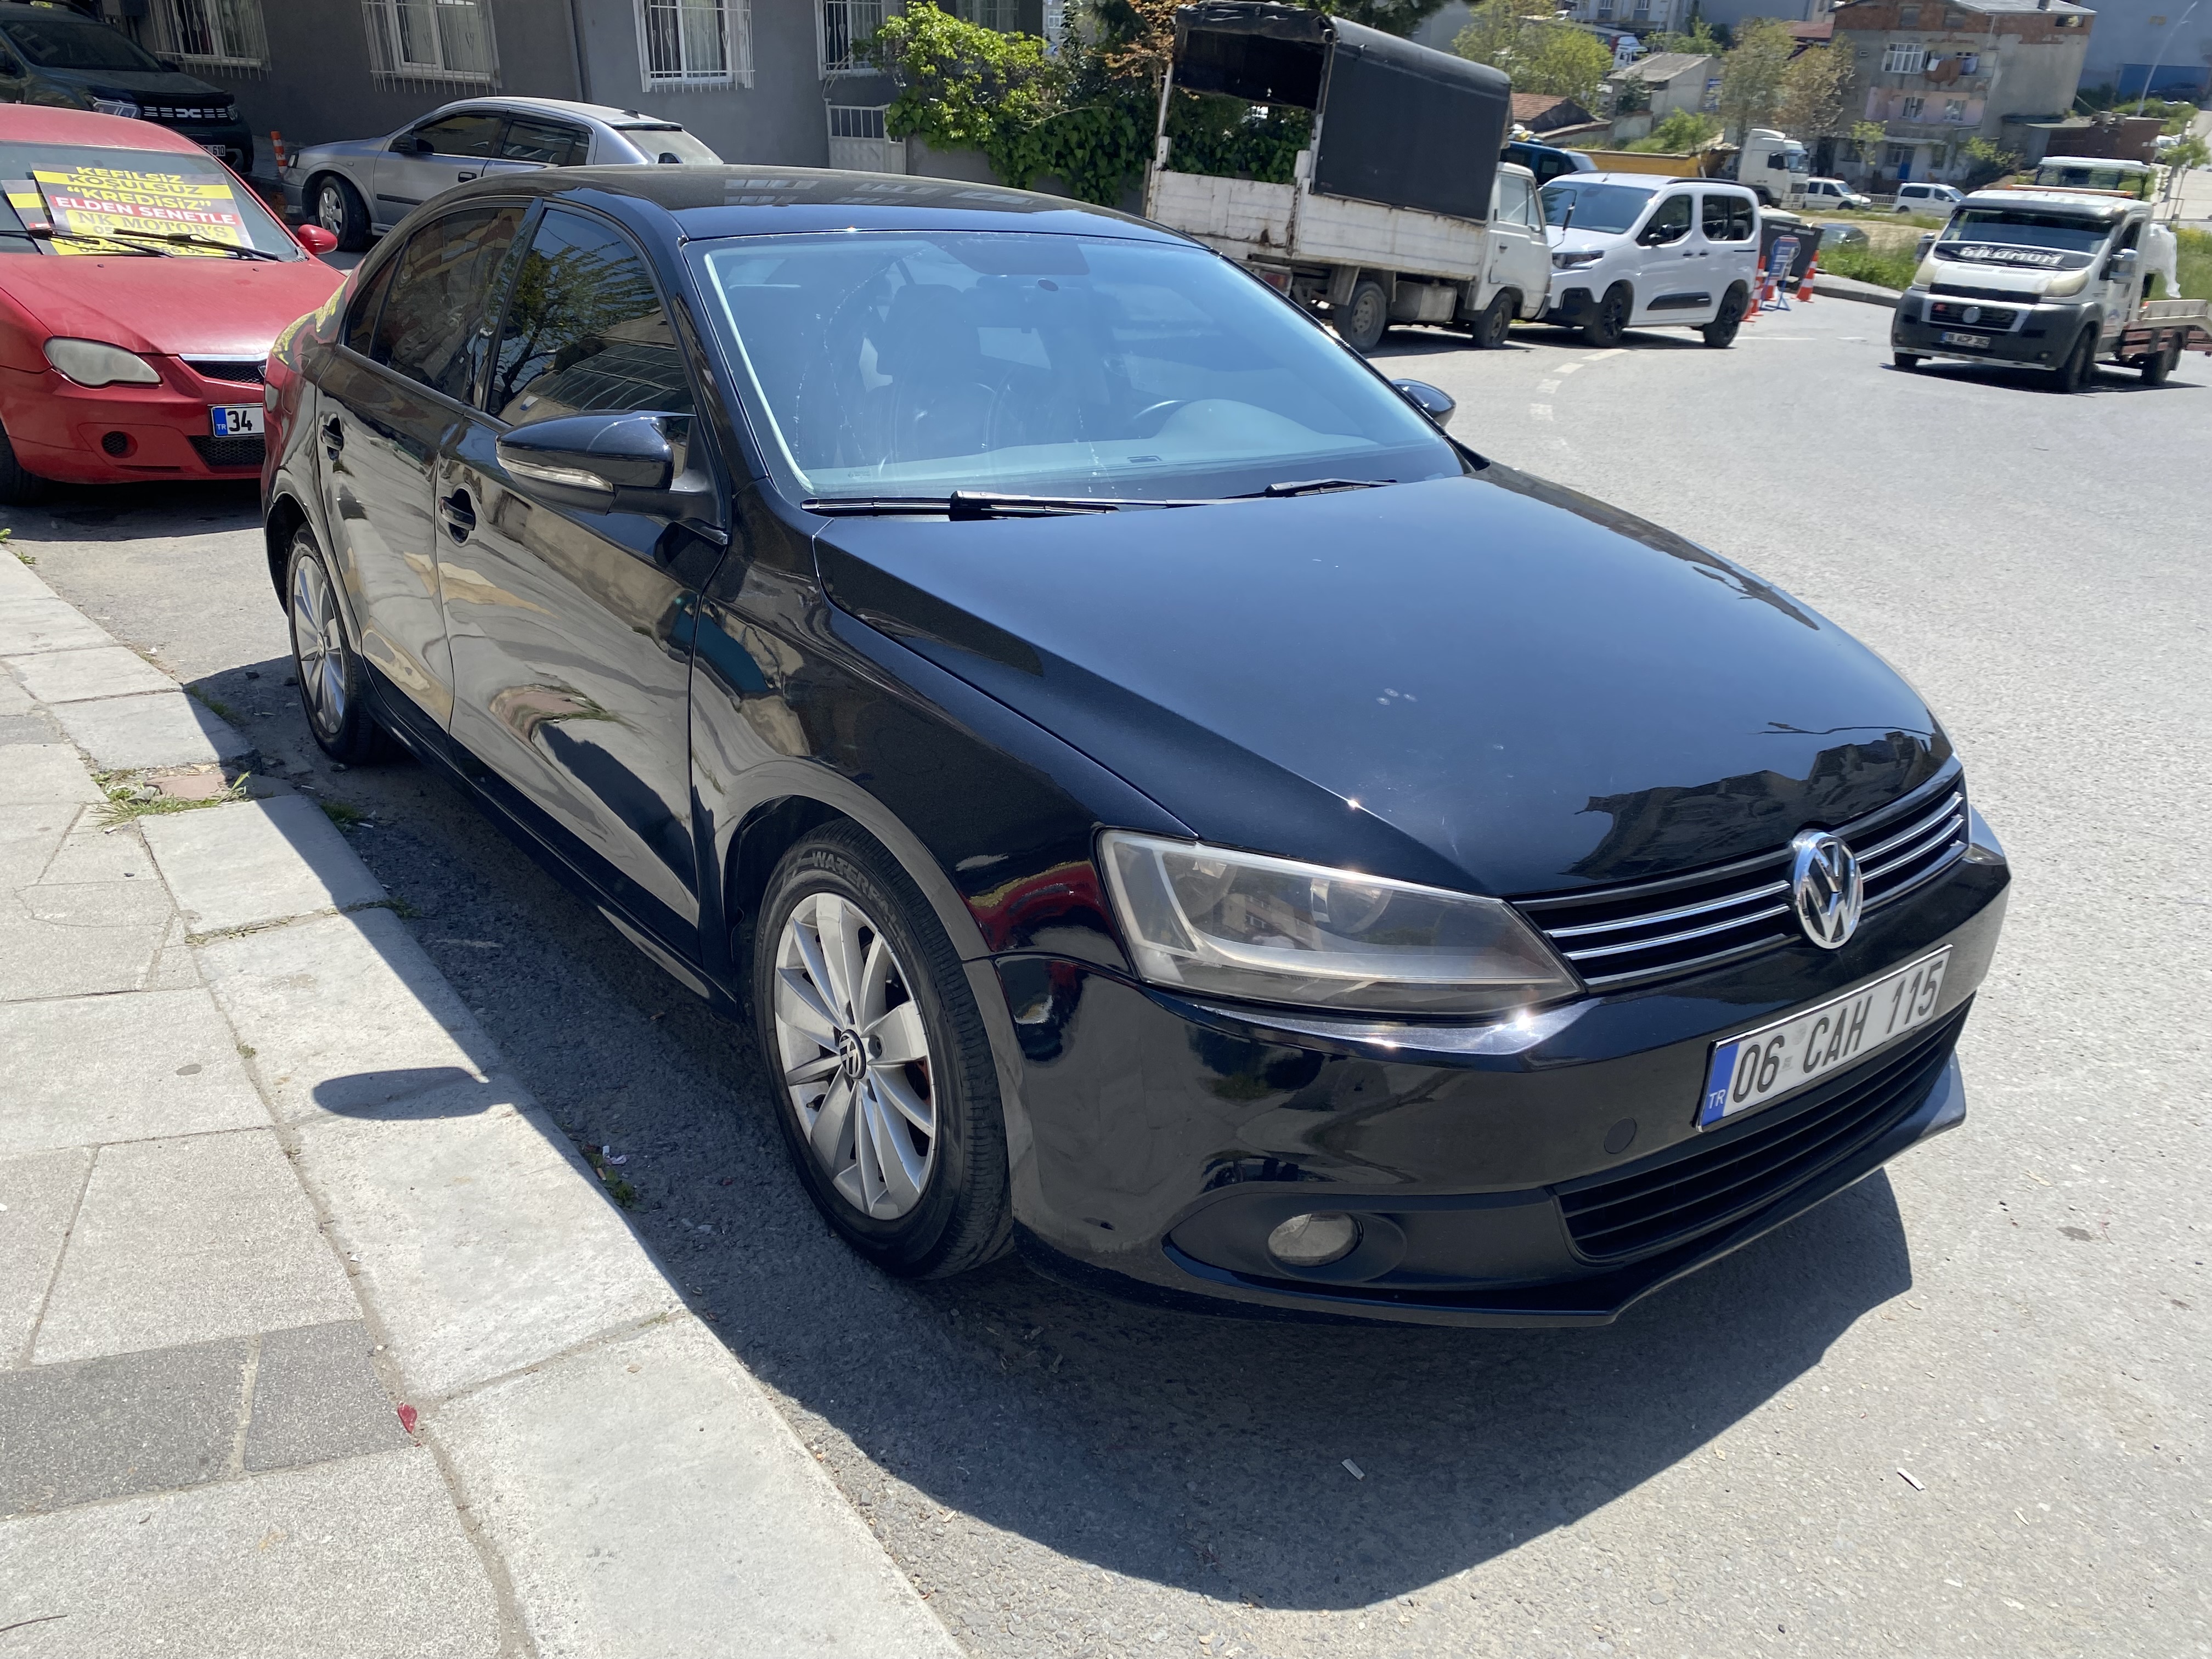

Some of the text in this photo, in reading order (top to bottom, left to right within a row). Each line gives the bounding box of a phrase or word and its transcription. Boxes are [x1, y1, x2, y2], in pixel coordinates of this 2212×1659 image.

[213, 146, 224, 155] 610
[55, 196, 236, 225] ELDEN SENETLE
[75, 211, 116, 227] NK
[227, 410, 253, 432] 34
[1708, 960, 1944, 1110] TR 06 CAH 115
